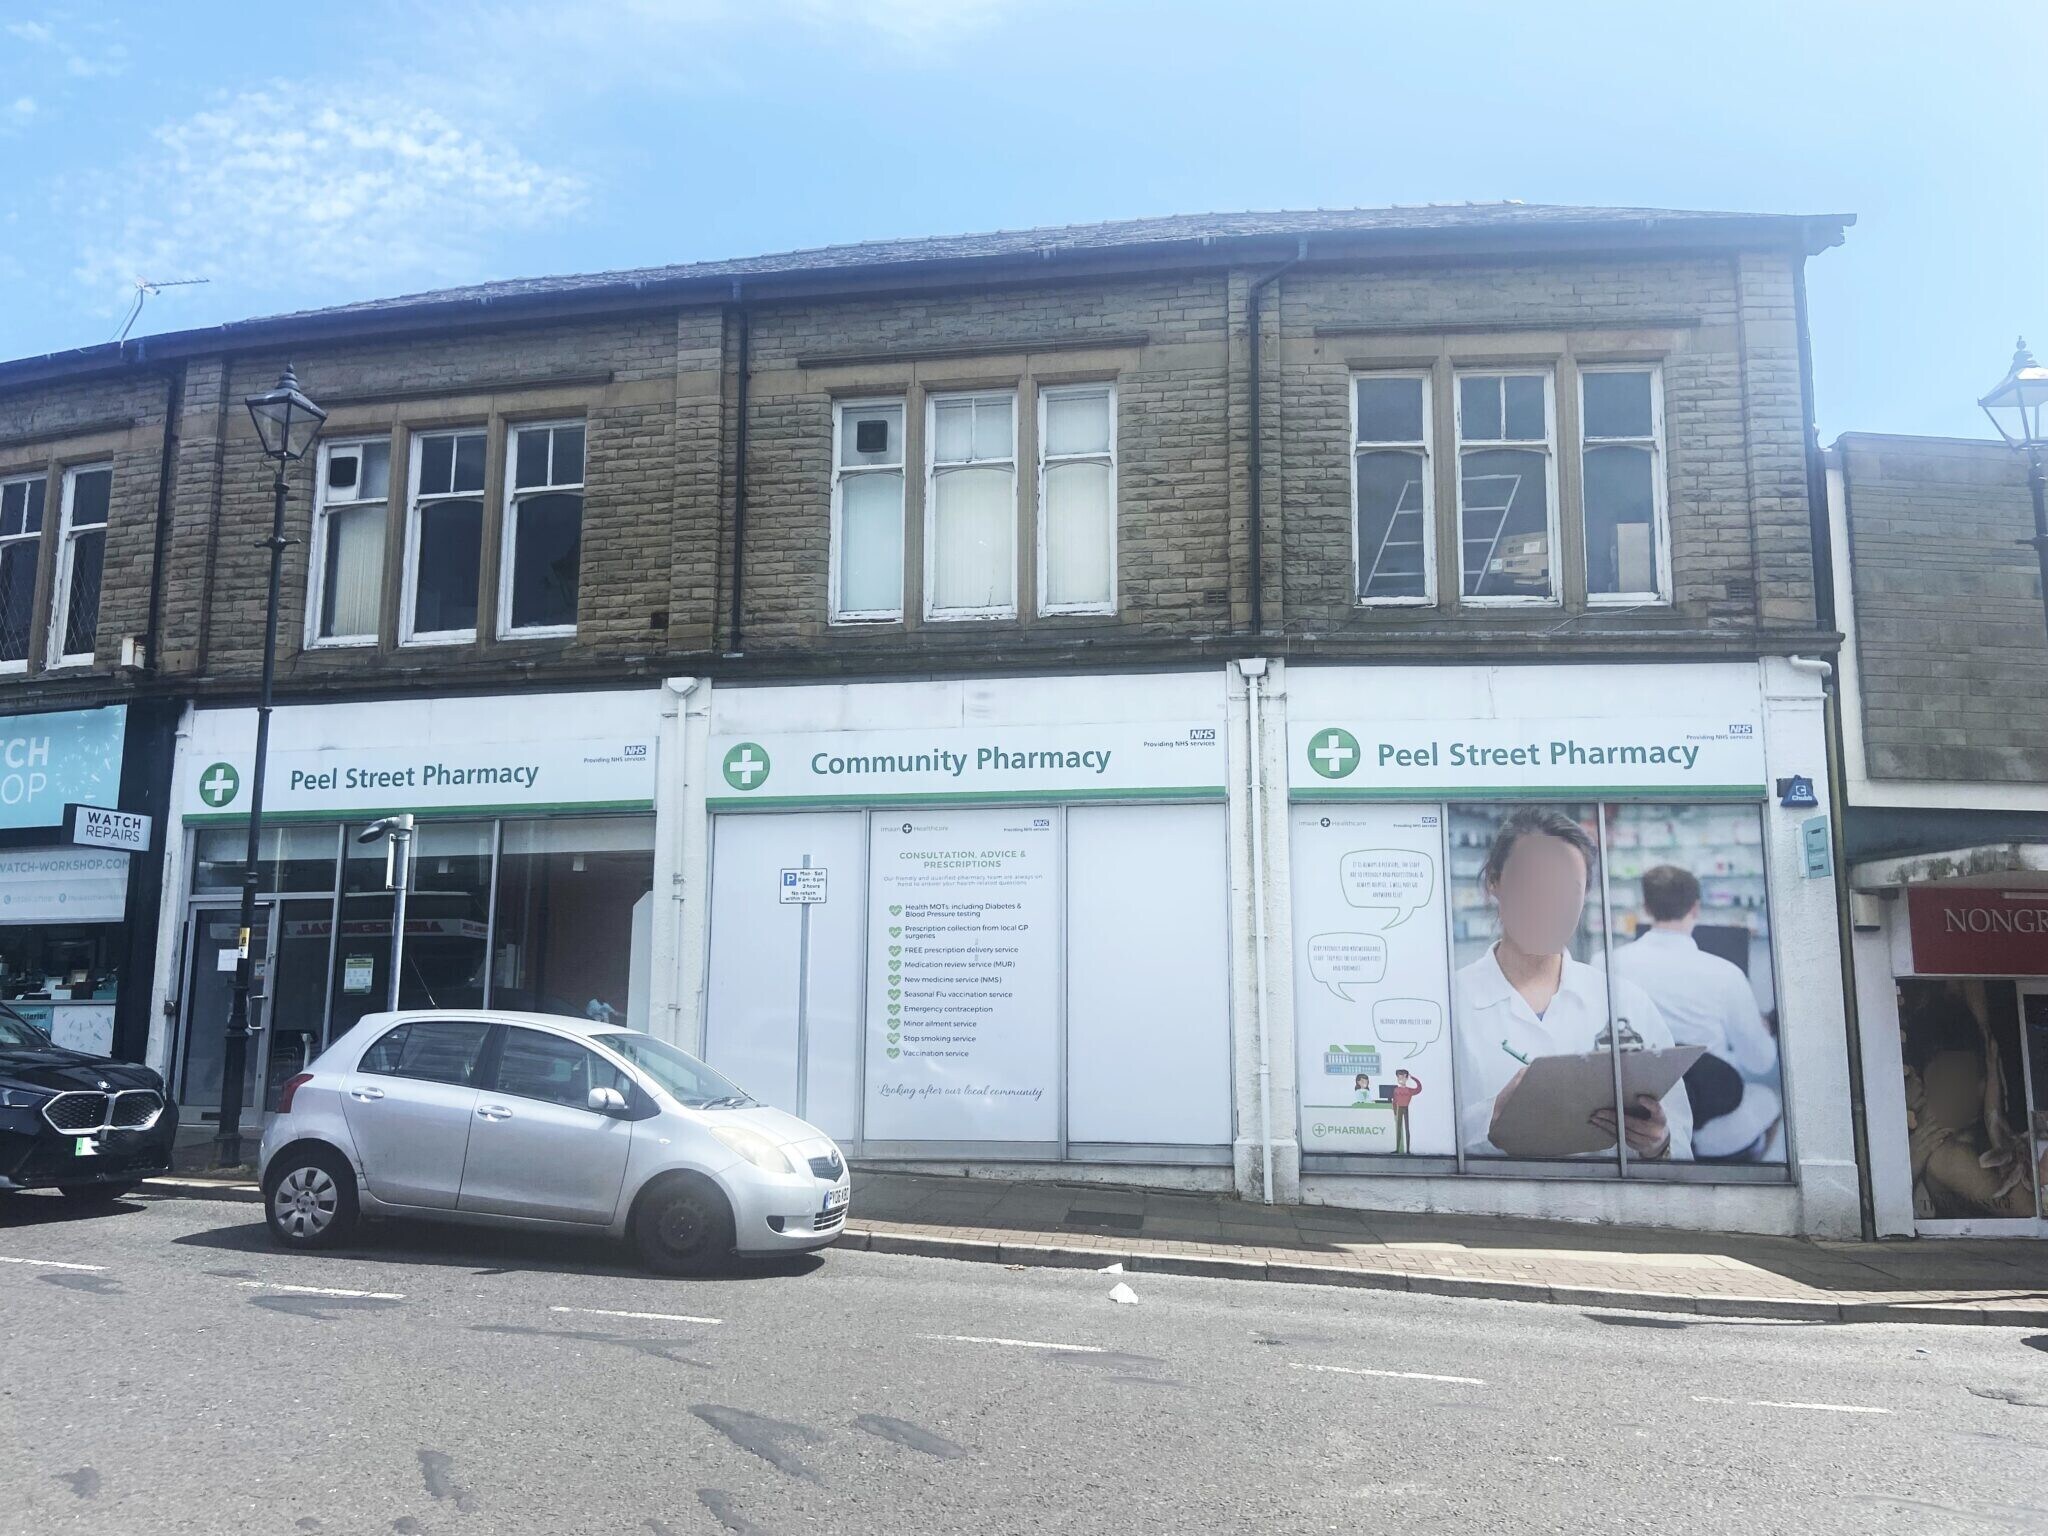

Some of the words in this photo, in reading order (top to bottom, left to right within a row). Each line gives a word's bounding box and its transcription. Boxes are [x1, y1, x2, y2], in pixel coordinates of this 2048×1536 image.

[1190, 729, 1215, 739] NHS
[1729, 724, 1752, 734] NHS
[0, 737, 50, 769] CH
[625, 745, 646, 755] NHS
[1378, 742, 1438, 767] Peel
[1449, 742, 1541, 767] Street
[1550, 740, 1699, 770] Pharmacy
[811, 747, 967, 777] Community
[976, 746, 1112, 774] Pharmacy
[290, 767, 338, 791] Peel
[345, 764, 415, 790] Street
[422, 762, 539, 788] Pharmacy
[88, 811, 142, 829] WATCH
[1034, 819, 1049, 827] NHS
[85, 824, 140, 842] REPAIRS
[980, 850, 1017, 858] ADVICE
[924, 860, 1001, 869] PRESCRIPTIONS
[1944, 908, 2048, 933] NONGR
[924, 947, 965, 955] prescription
[967, 946, 993, 954] delivery
[980, 976, 1002, 984] (NMS)
[903, 1035, 920, 1043] Stop
[921, 1035, 951, 1043] smoking
[918, 1084, 942, 1099] after
[963, 1084, 988, 1095] local
[1327, 1126, 1386, 1135] PHARMACY
